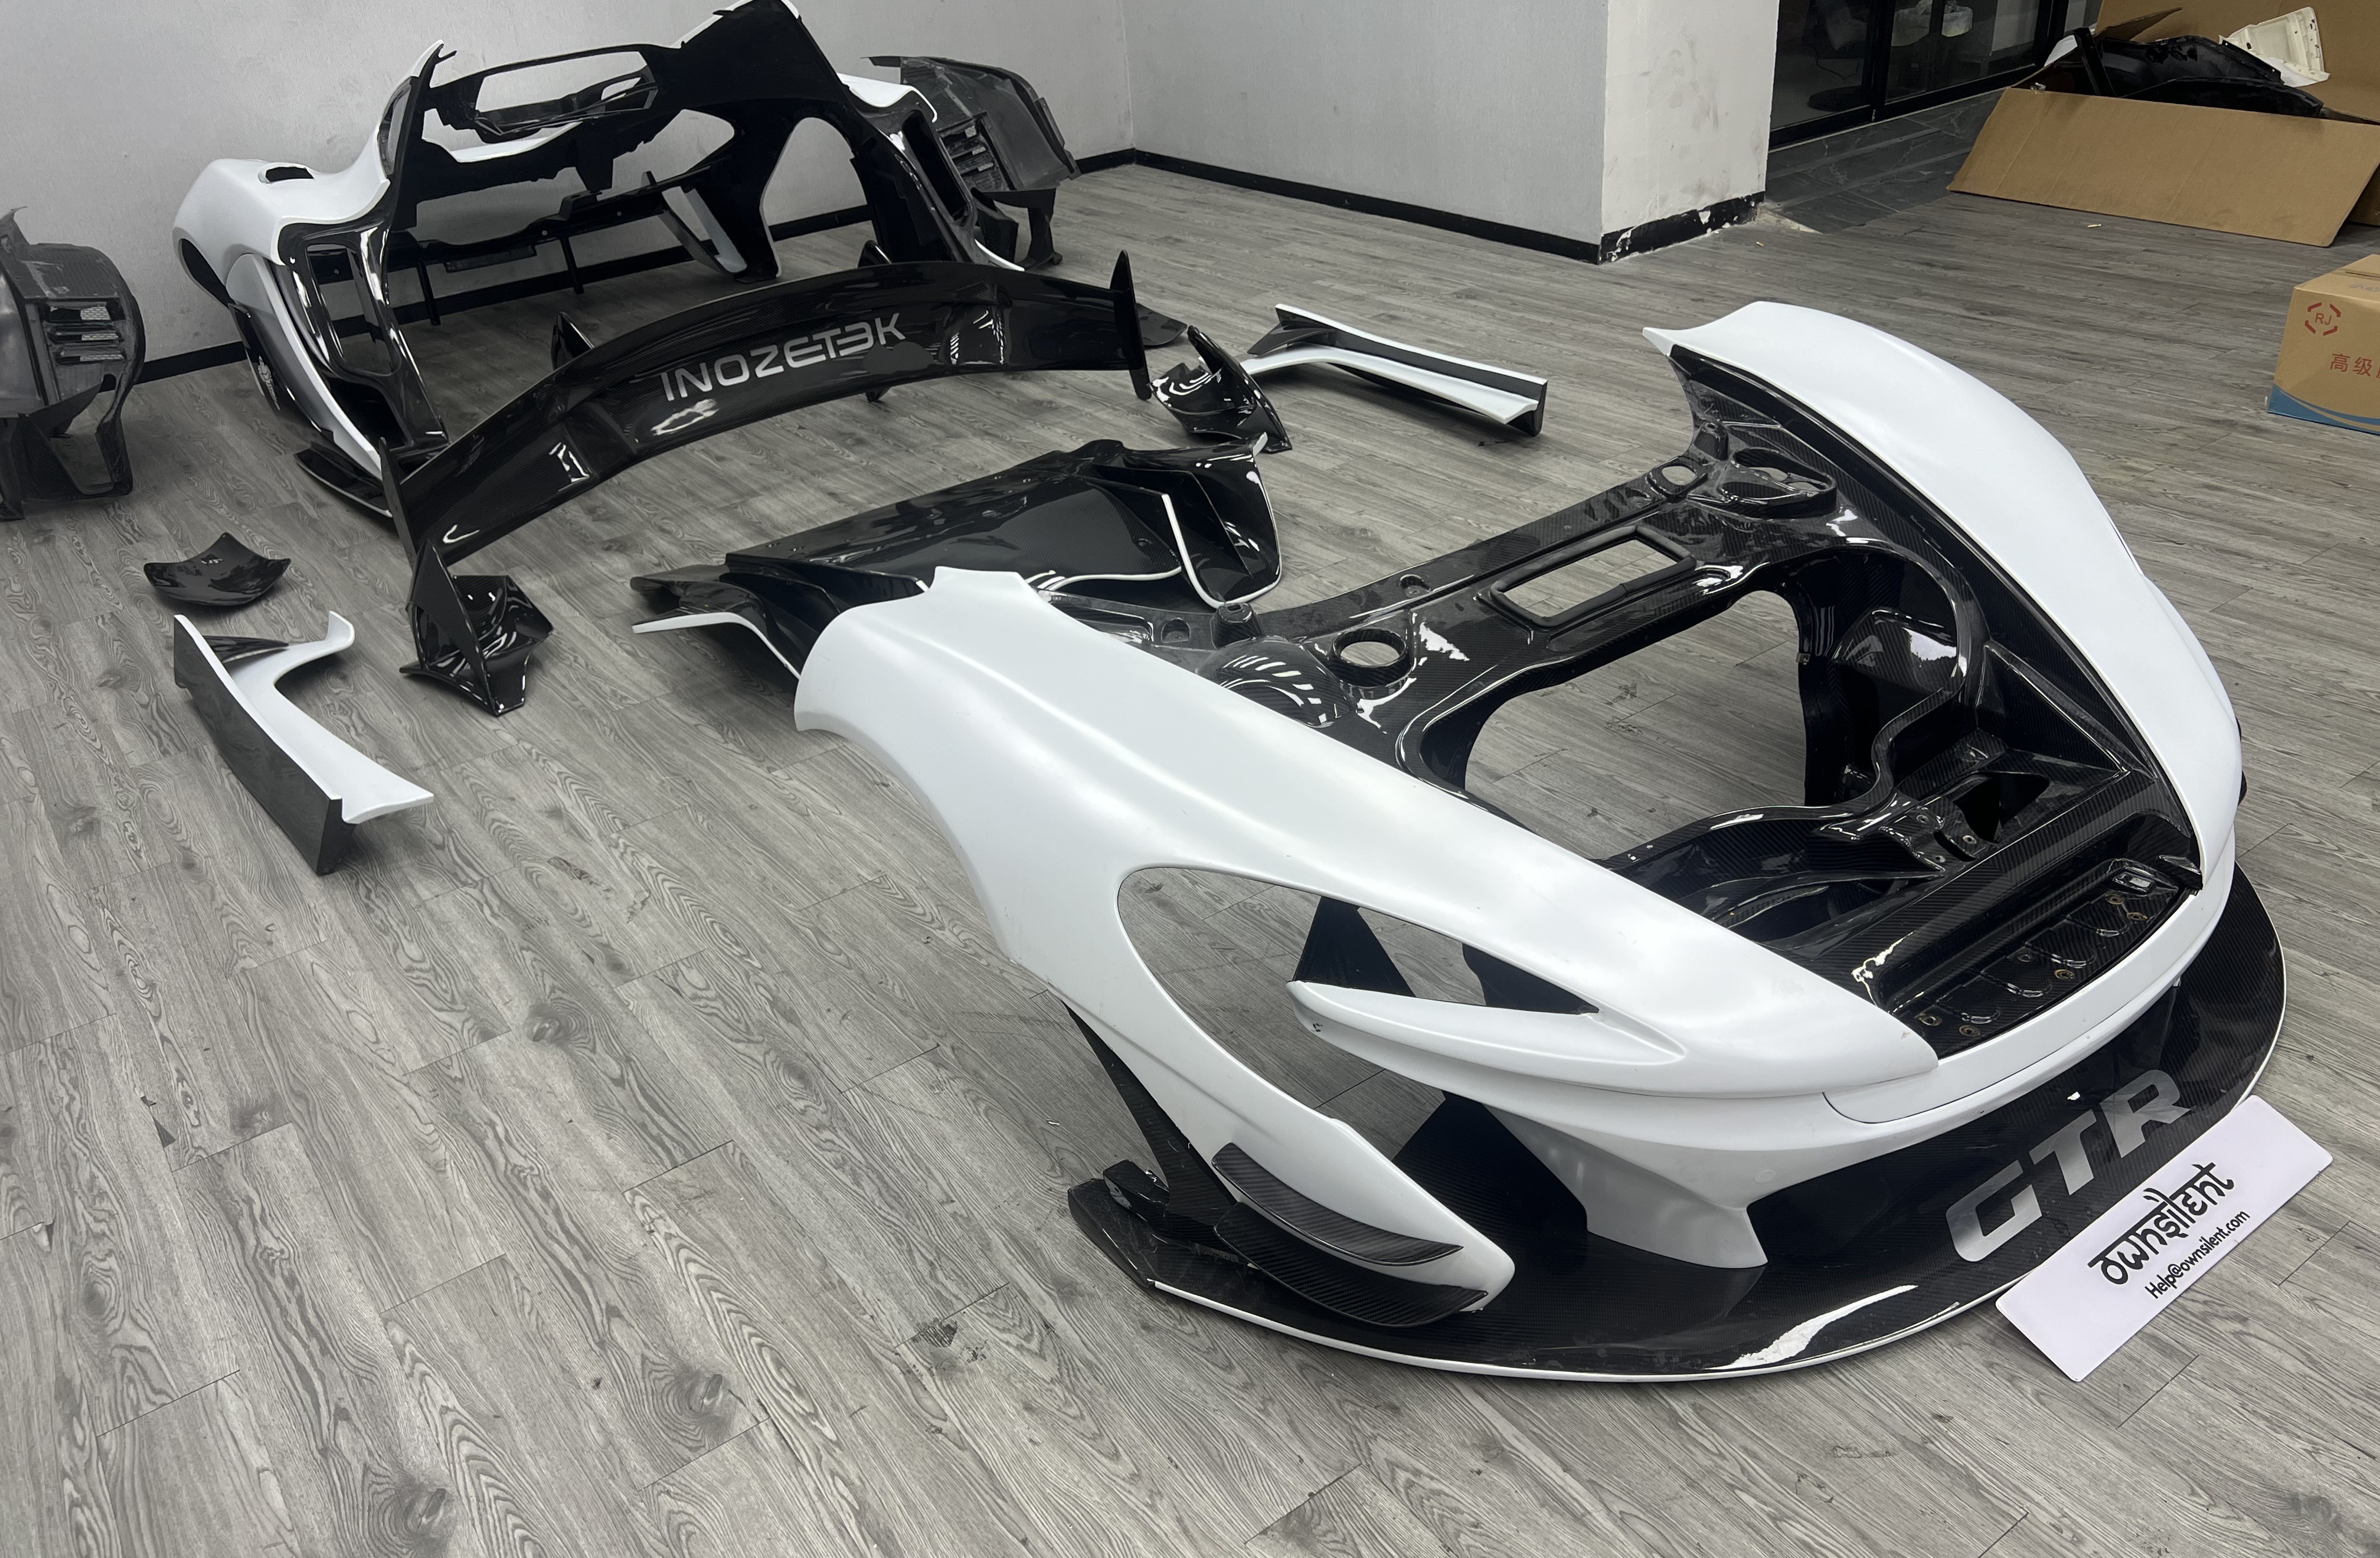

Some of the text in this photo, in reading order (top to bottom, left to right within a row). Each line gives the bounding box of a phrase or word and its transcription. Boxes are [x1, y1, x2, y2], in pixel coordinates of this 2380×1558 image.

[2314, 313, 2332, 325] RJ
[2330, 354, 2380, 379] 高级
[1946, 1069, 2191, 1262] GTR
[2144, 1211, 2250, 1299] Help@ownsilent.com
